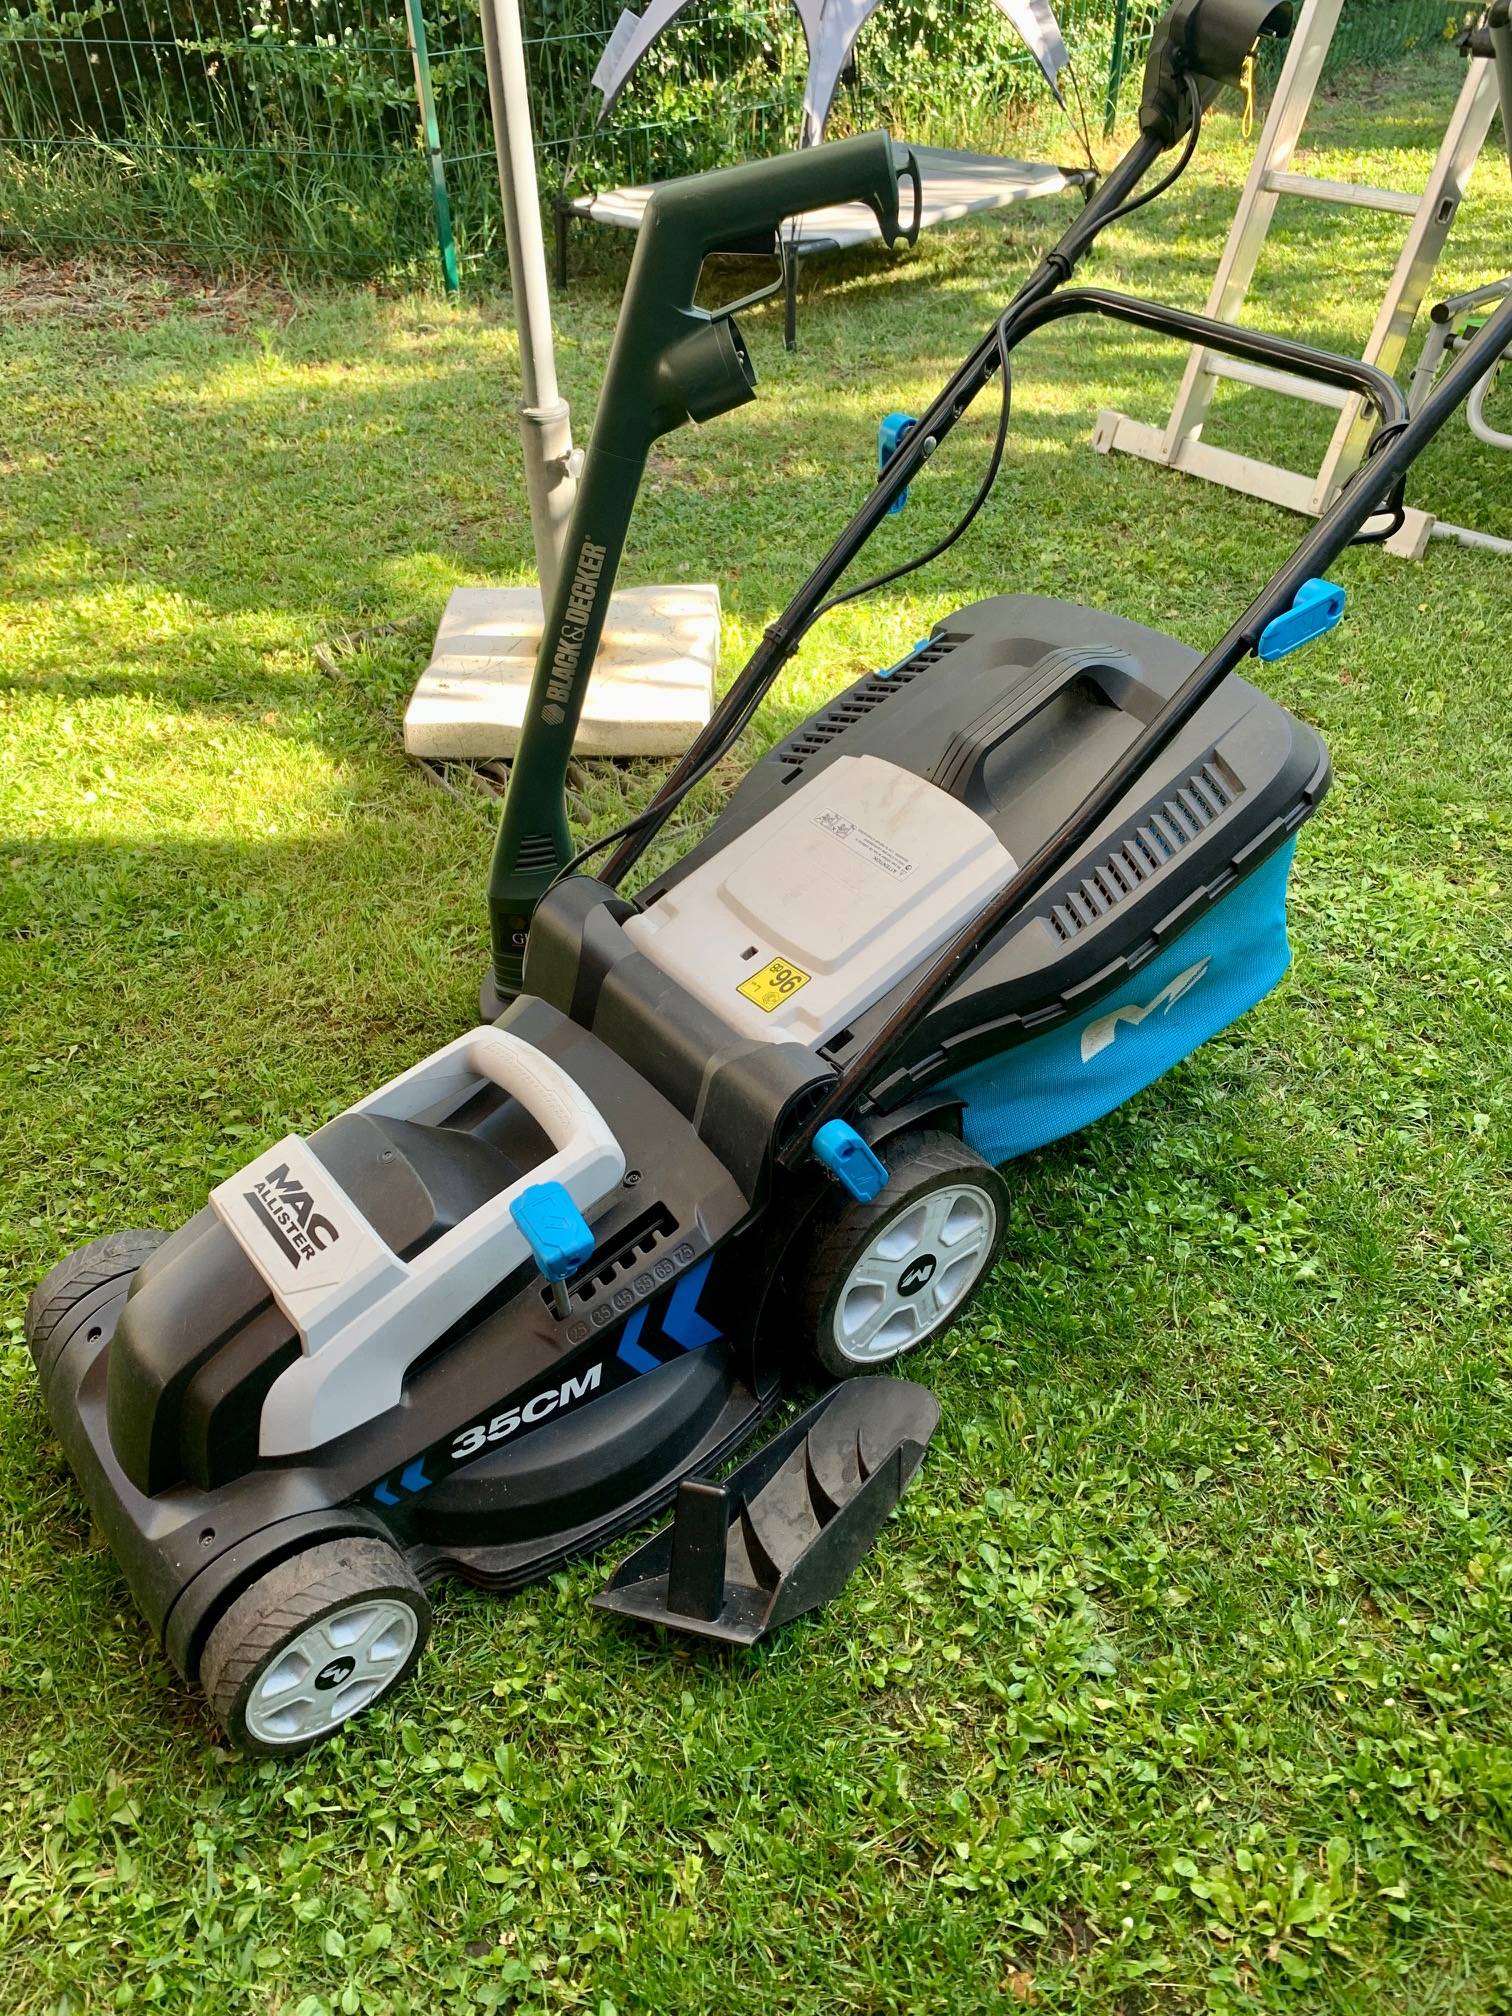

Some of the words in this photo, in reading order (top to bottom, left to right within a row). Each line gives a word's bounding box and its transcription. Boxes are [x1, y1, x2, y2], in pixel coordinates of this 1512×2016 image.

[769, 969, 803, 993] 96
[253, 1182, 316, 1261] ALLISTER
[264, 1162, 340, 1252] MAC
[592, 1306, 611, 1323] 35
[655, 1262, 673, 1279] 65
[675, 1247, 693, 1264] 75
[450, 1362, 603, 1460] 35CM
